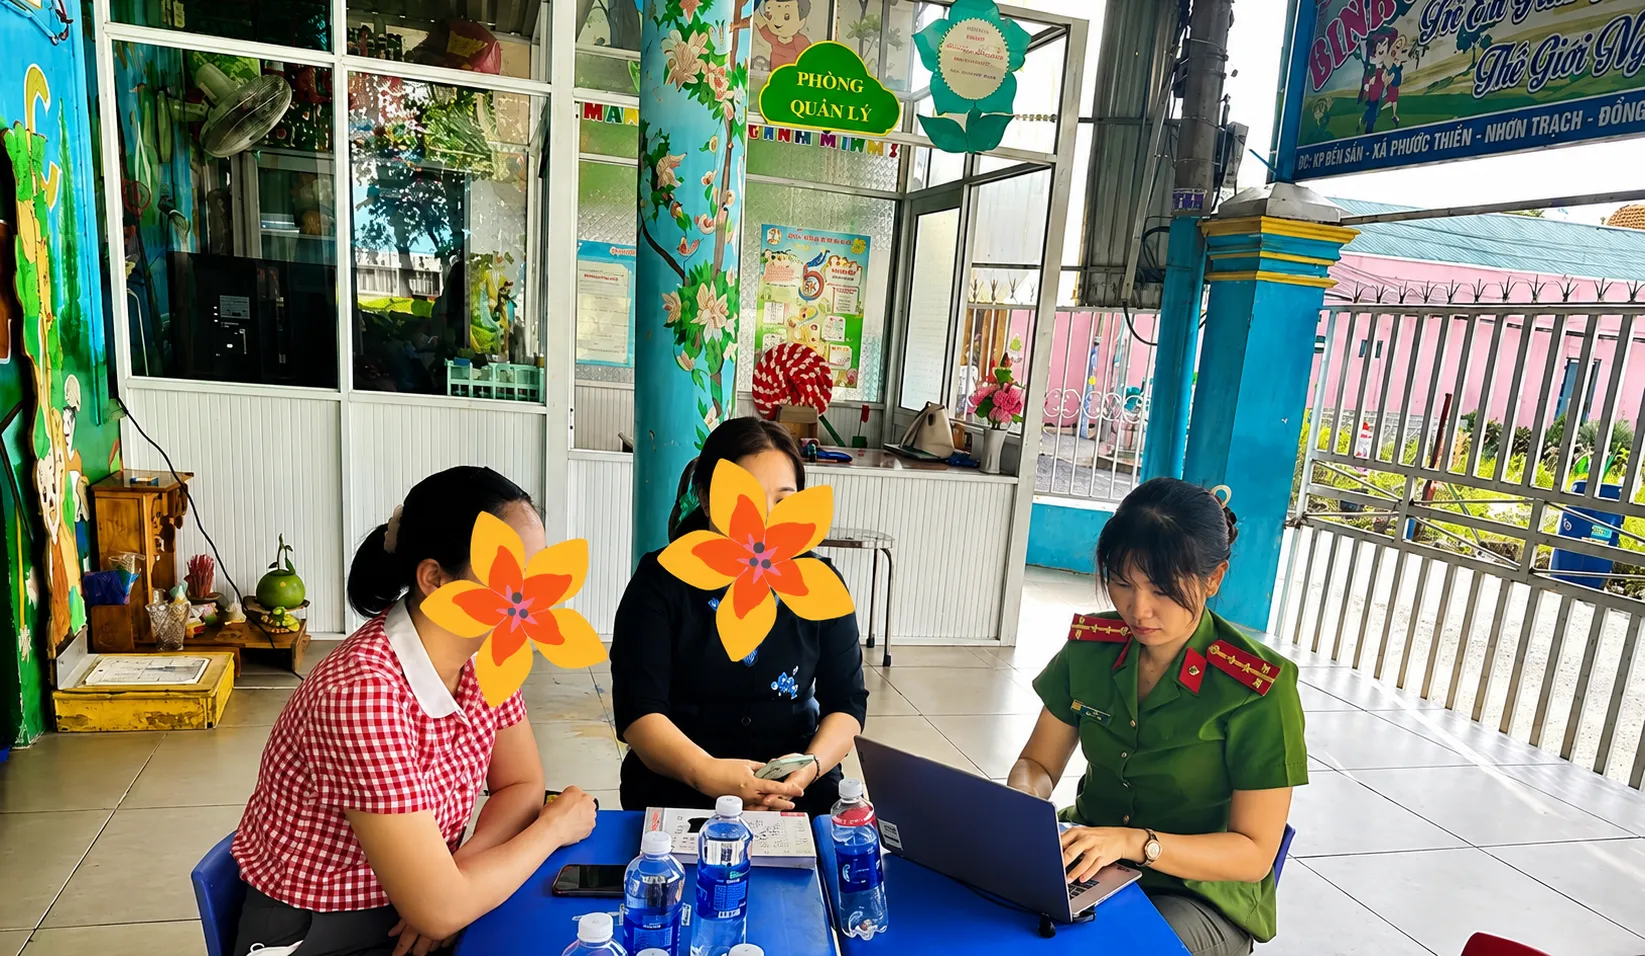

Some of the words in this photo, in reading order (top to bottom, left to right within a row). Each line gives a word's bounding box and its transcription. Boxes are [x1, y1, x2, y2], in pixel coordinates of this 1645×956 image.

[1473, 40, 1529, 98] Thế
[1527, 32, 1593, 93] Giới
[796, 70, 864, 93] PHÒNG
[790, 98, 844, 119] QUẢN
[847, 103, 872, 122] LÝ
[1530, 110, 1583, 138] TRẠCH
